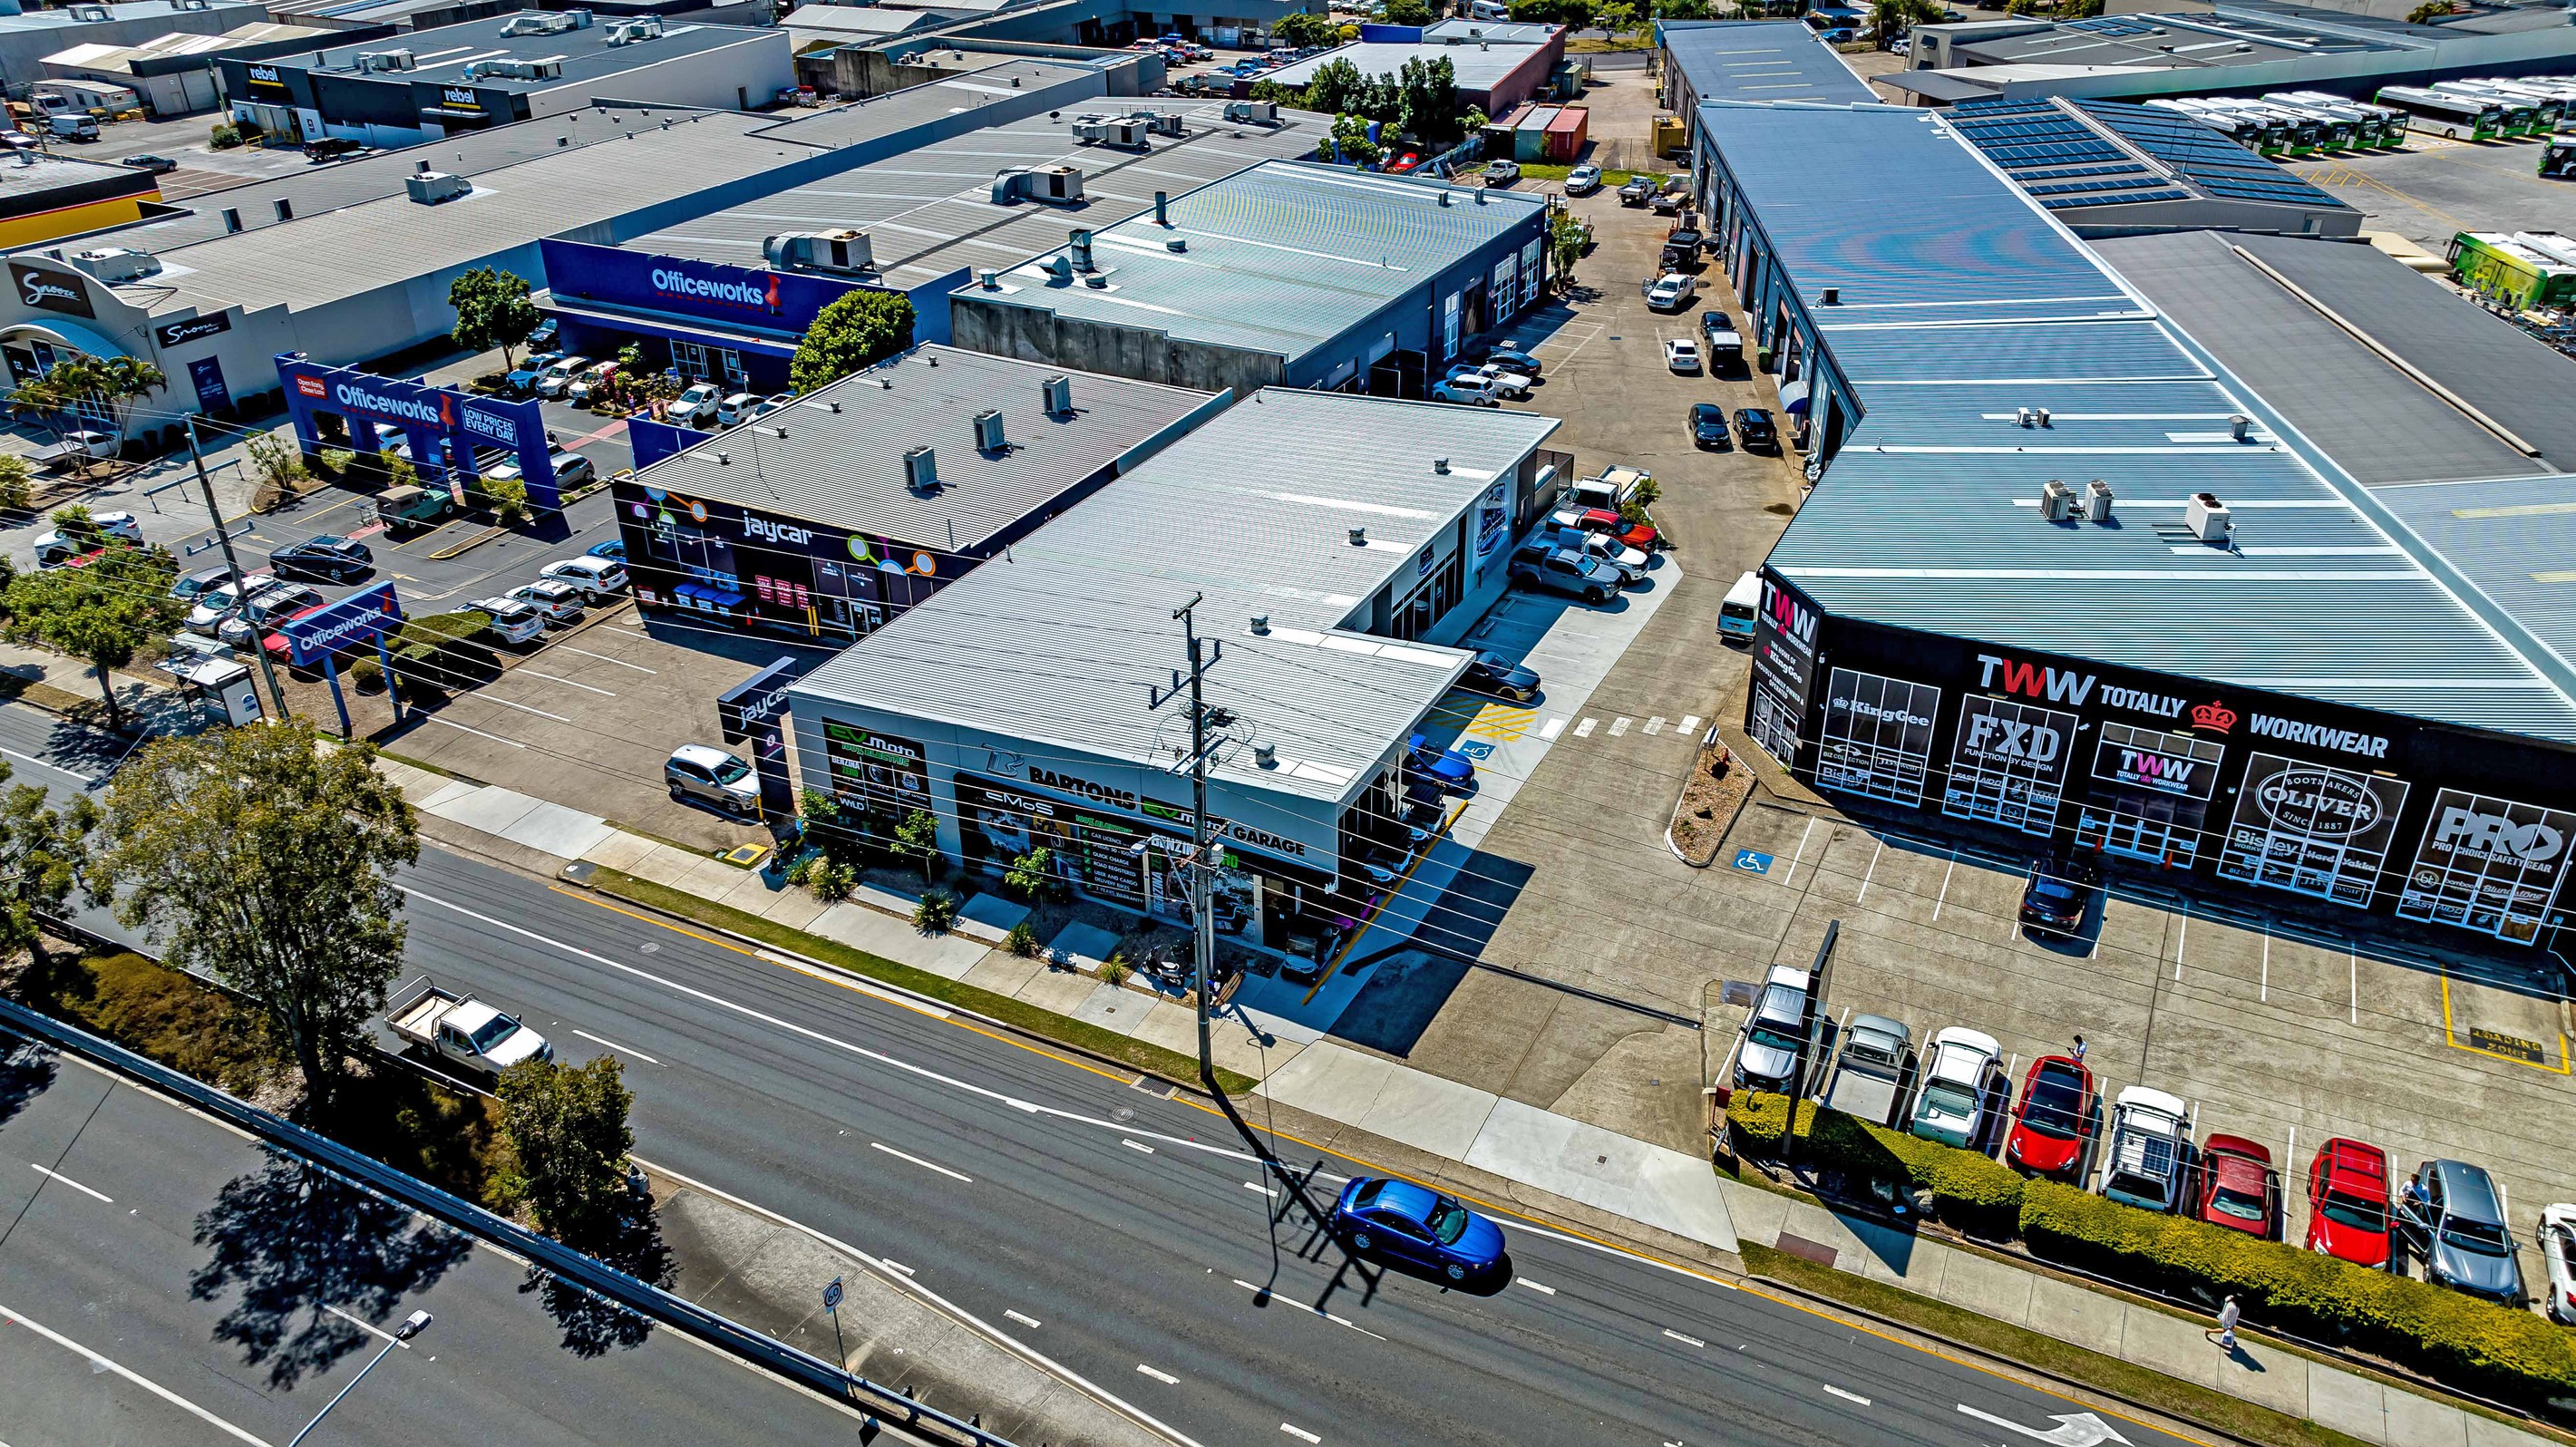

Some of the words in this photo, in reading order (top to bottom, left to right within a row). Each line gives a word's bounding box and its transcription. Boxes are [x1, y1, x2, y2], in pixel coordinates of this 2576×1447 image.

[249, 66, 279, 82] rebel
[444, 88, 474, 104] rebel
[24, 273, 81, 305] Snooze
[652, 268, 763, 305] Officeworks
[167, 323, 218, 344] Snooze
[336, 384, 440, 423] Officeworks
[463, 407, 483, 422] LOW
[483, 413, 513, 432] PRICES
[465, 419, 494, 435] EVERY
[496, 426, 514, 442] DAY
[744, 510, 812, 545] jaycar
[1764, 579, 1816, 643] TWW
[300, 605, 382, 652] Officeworks
[1761, 610, 1779, 630] TOTALLY
[1785, 630, 1813, 659] WORKWEAR
[1771, 640, 1779, 651] THE
[1778, 646, 1791, 660] HOME
[1755, 659, 1774, 680] PROUDLY
[1772, 673, 1786, 689] FAMILY
[1785, 684, 1801, 700] OWNED
[1769, 650, 1803, 685] KingGee
[1768, 680, 1788, 700] OPERATED
[1849, 701, 1930, 726] KingGee
[1978, 654, 2096, 706] TWW
[2100, 685, 2186, 718] TOTALLY
[2250, 713, 2389, 759] WORKWEAR
[1773, 713, 1795, 744] HEGHT
[1770, 731, 1793, 762] SAETY
[1833, 753, 1870, 765] COLECTION
[1964, 747, 2007, 762] FUNCTION
[2008, 757, 2020, 765] BY
[2020, 759, 2053, 772] DESIGN
[2121, 750, 2194, 782] TWW
[1823, 766, 1864, 786] Bisley
[2116, 770, 2141, 780] TOTALLY
[2152, 778, 2188, 791] WORKWEAR
[840, 797, 865, 811] WYLD
[1029, 765, 1136, 811] BARTONS
[1233, 826, 1305, 857] GARAGE
[2263, 786, 2372, 821] OLIVER
[2318, 821, 2343, 830] 1887
[2435, 806, 2562, 861] PRO
[1151, 832, 1195, 856] BENZIN
[2234, 829, 2299, 857] Bisley
[1093, 851, 1108, 860] QUICK
[1109, 856, 1130, 866] CHARGE
[1093, 860, 1107, 869] ROAD
[2432, 840, 2453, 852] PRO
[2455, 846, 2490, 859] CHOICE
[2492, 853, 2526, 868] SAFETY
[2526, 860, 2552, 873] GEAR
[2483, 884, 2547, 900] Blunstone
[2473, 1028, 2541, 1051] LOADING
[2486, 1043, 2528, 1060] ZONE
[827, 1287, 840, 1303] 60
